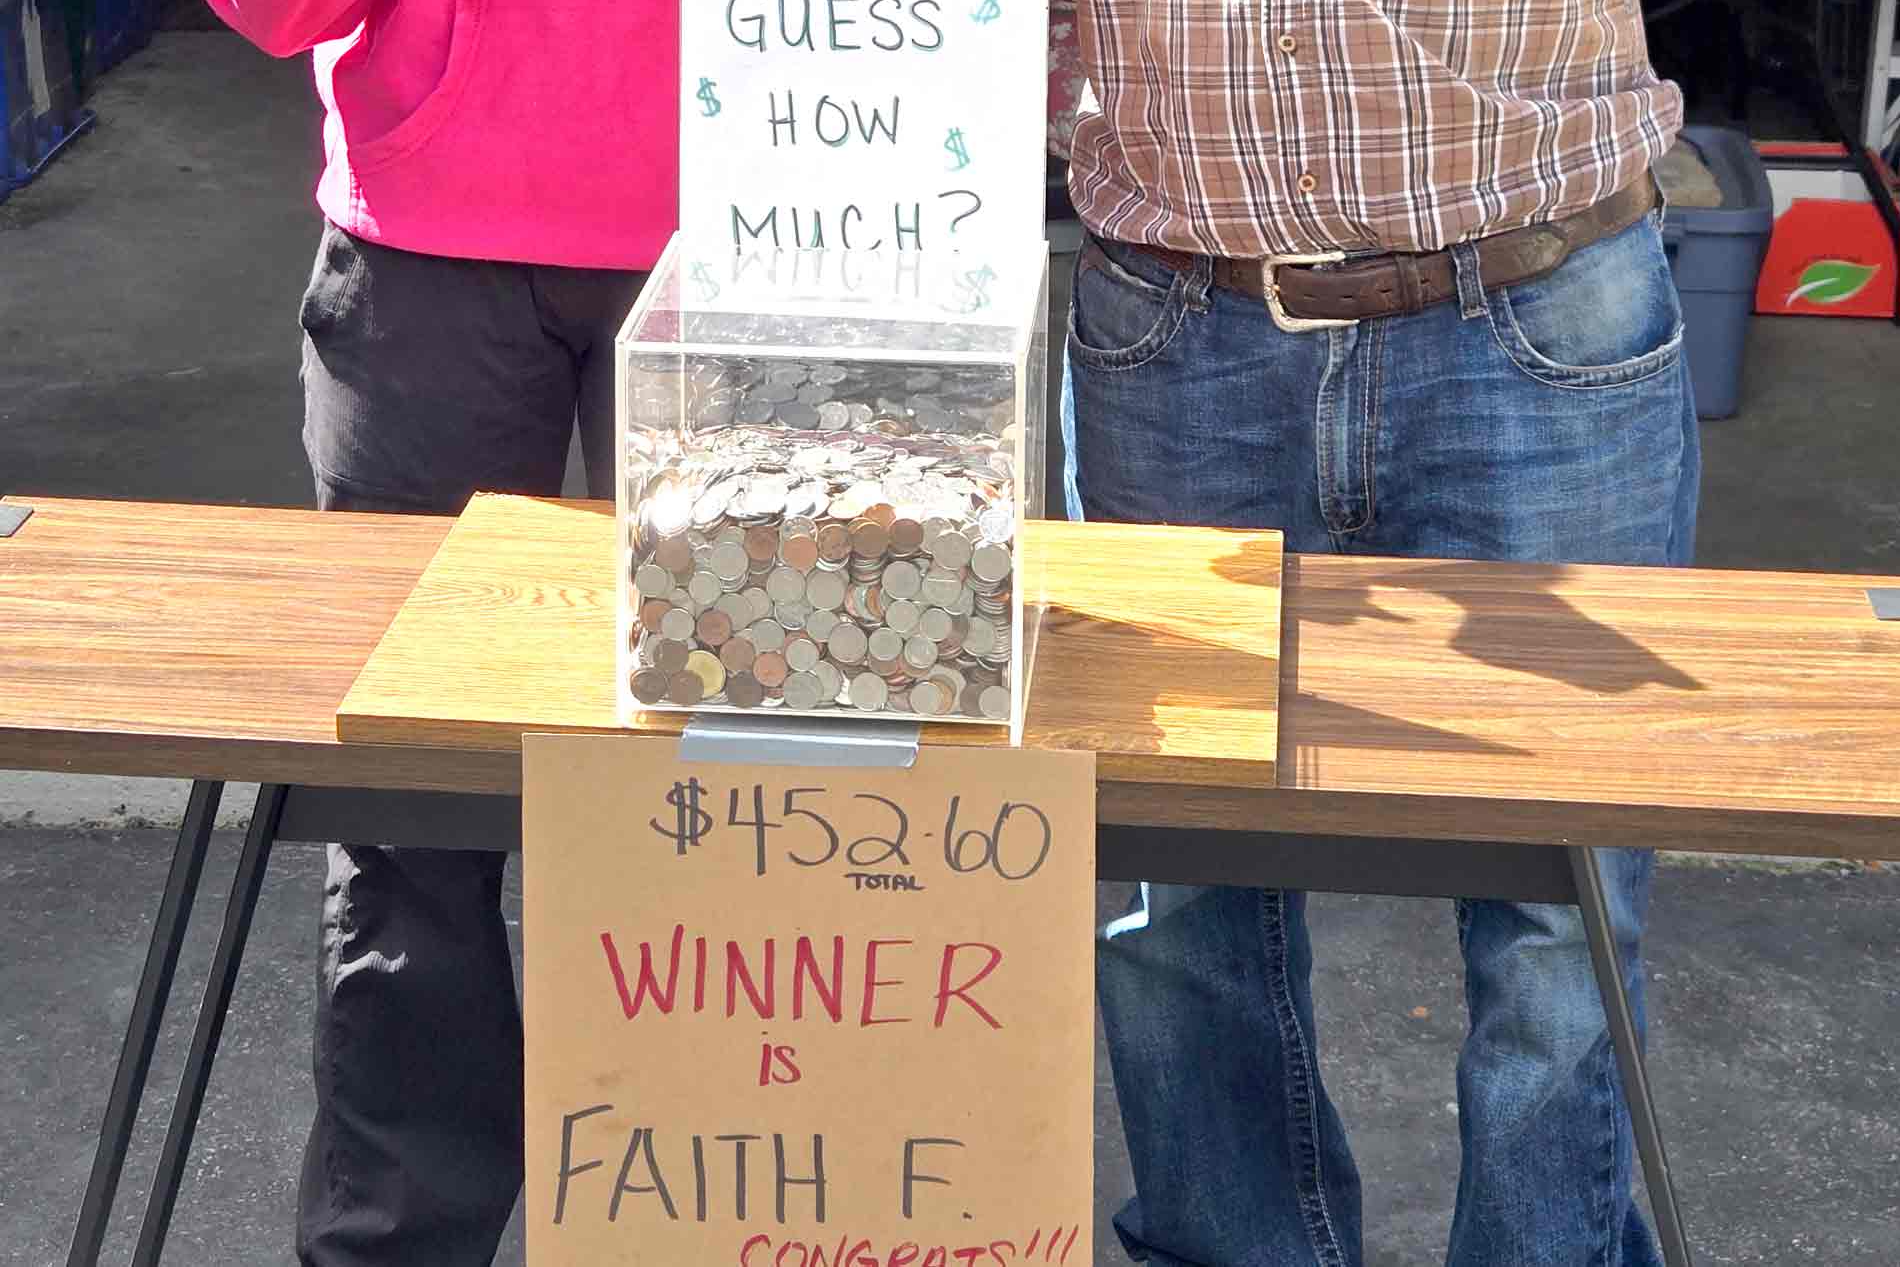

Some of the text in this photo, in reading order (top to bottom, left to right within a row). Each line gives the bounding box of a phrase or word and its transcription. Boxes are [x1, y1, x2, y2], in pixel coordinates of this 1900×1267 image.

[696, 78, 722, 117] $
[768, 89, 900, 147] HOW
[944, 126, 970, 171] $
[730, 190, 981, 253] MUCH?
[844, 871, 926, 891] TOTAL
[600, 923, 1005, 1030] WINNER
[552, 1103, 974, 1225] FAITH F.
